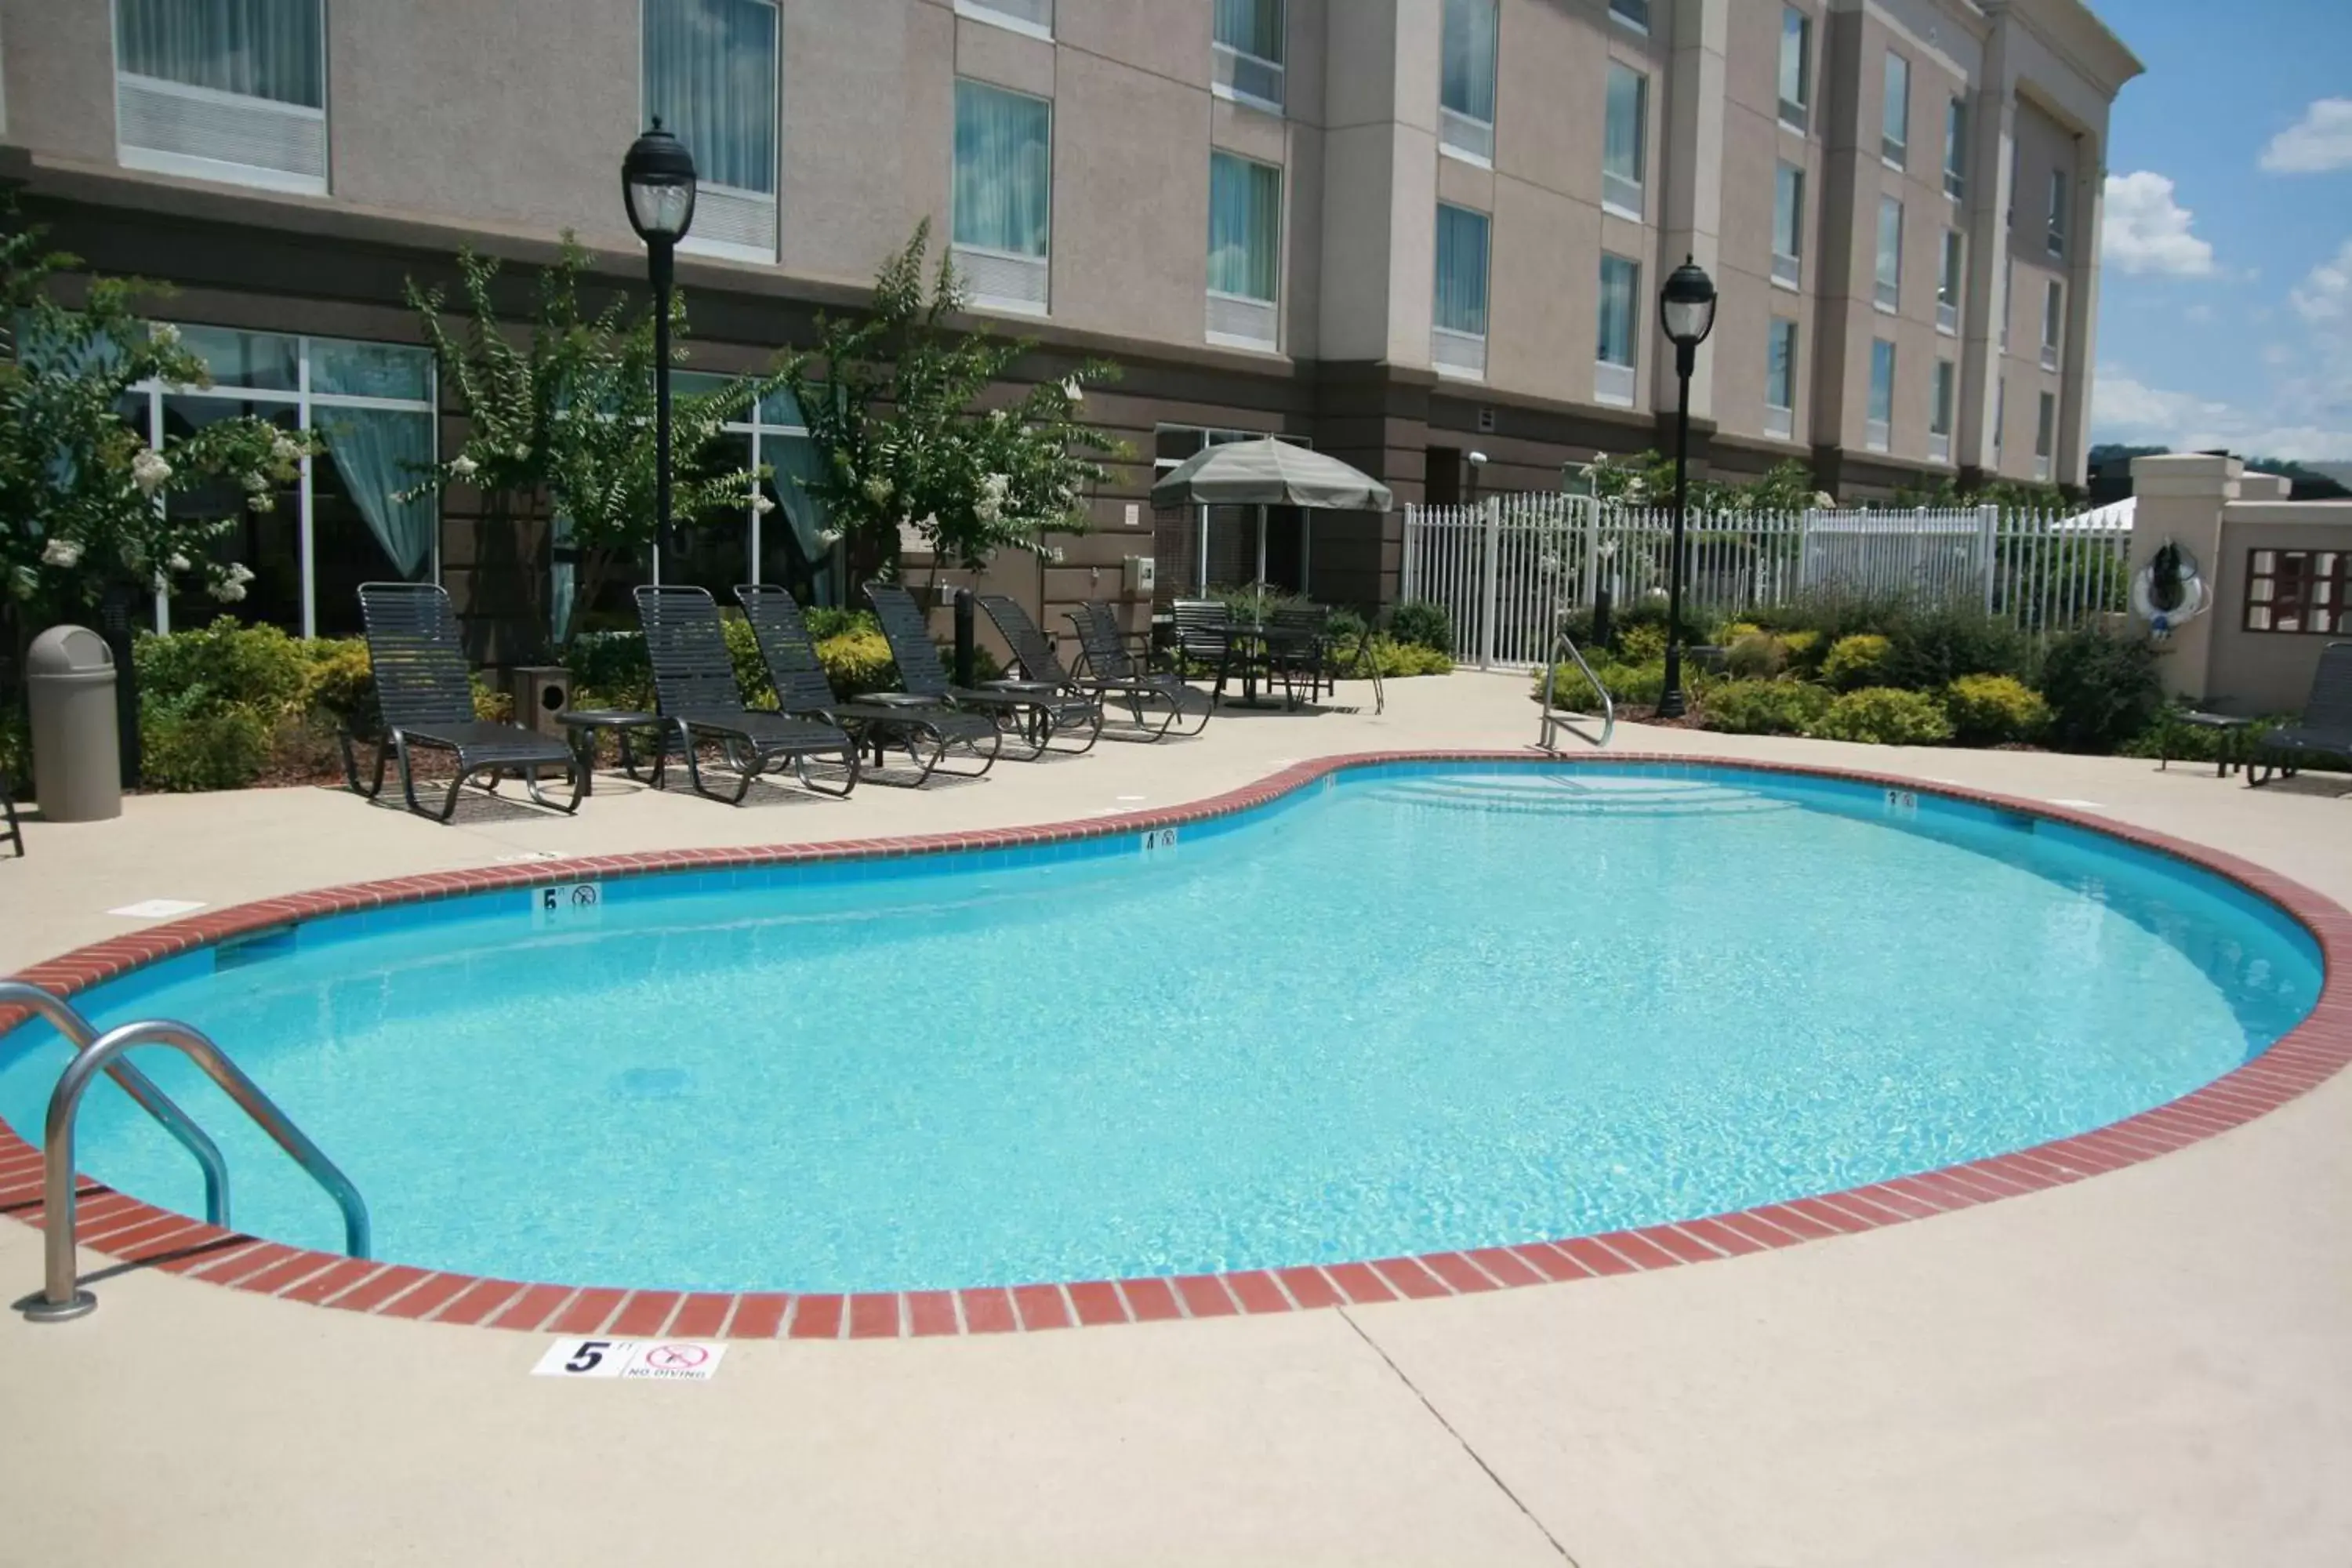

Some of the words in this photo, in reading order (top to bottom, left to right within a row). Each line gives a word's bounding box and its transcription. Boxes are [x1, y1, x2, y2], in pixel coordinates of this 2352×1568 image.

[544, 888, 557, 909] 5
[564, 1341, 612, 1373] 5
[628, 1367, 650, 1376] NO
[654, 1368, 706, 1378] DIVING
